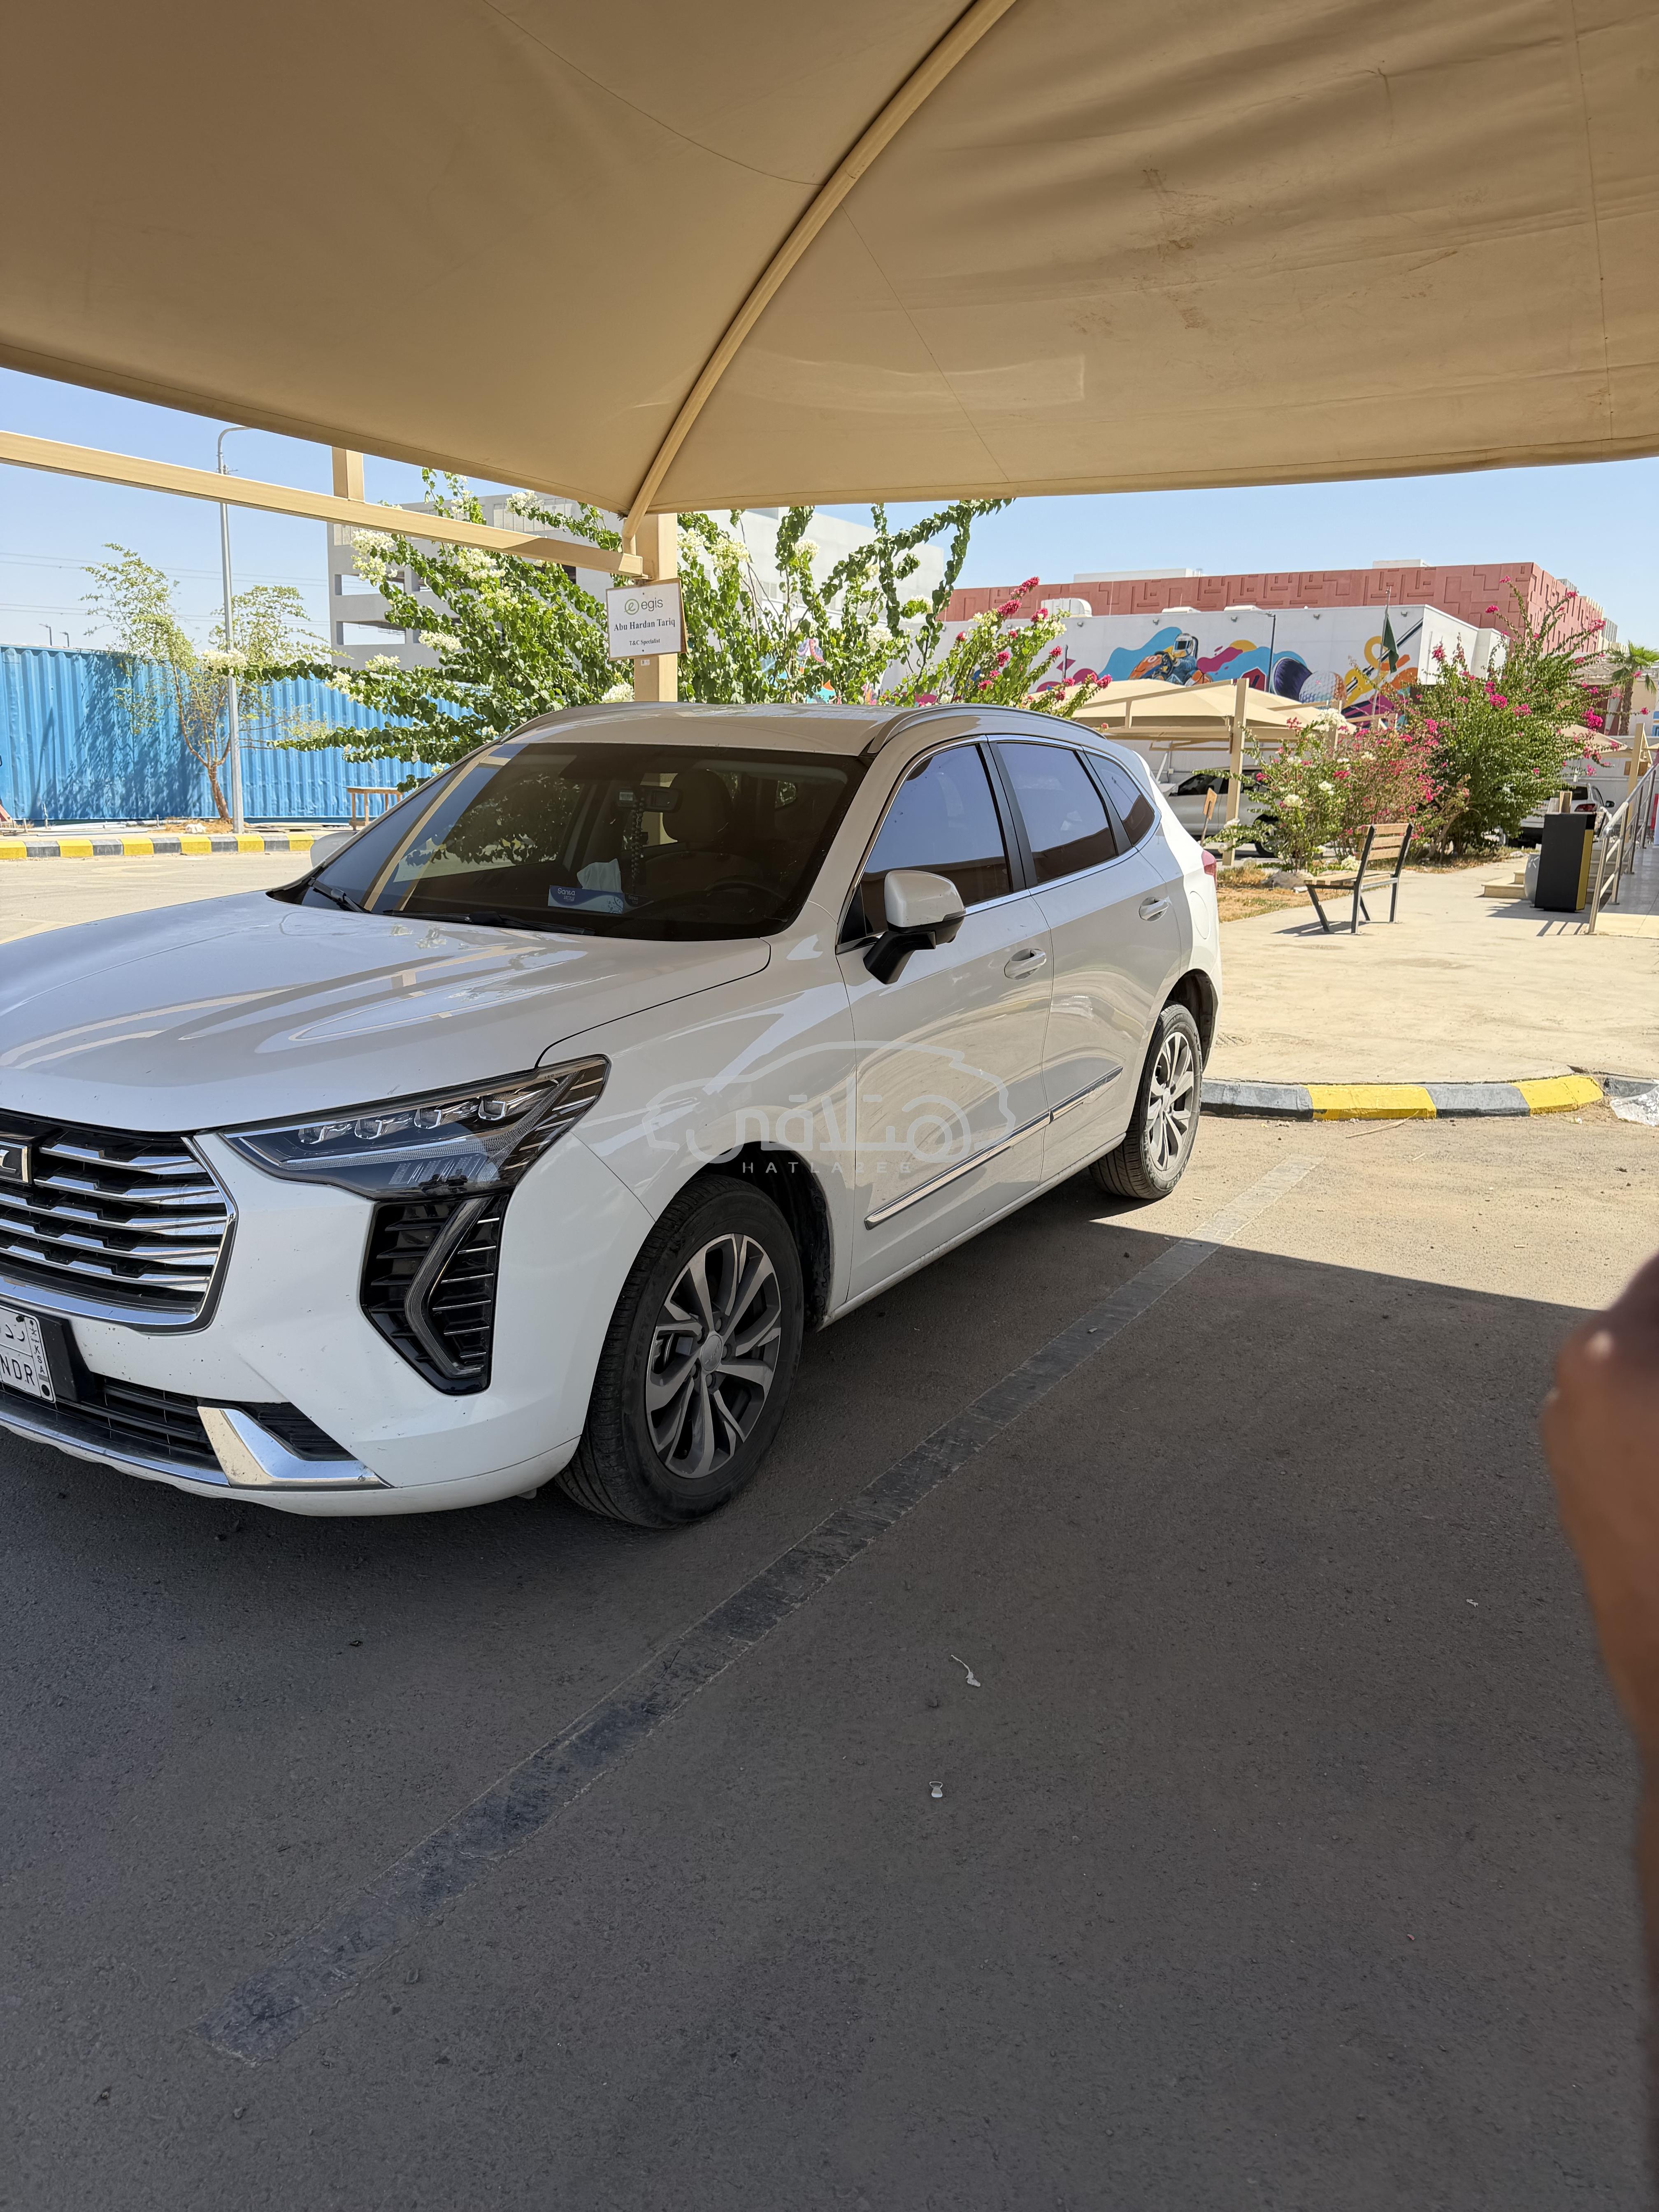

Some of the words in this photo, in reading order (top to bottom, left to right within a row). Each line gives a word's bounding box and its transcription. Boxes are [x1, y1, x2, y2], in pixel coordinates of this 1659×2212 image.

[641, 597, 663, 612] egis
[630, 620, 655, 630] Hardan
[657, 618, 676, 627] Tariq
